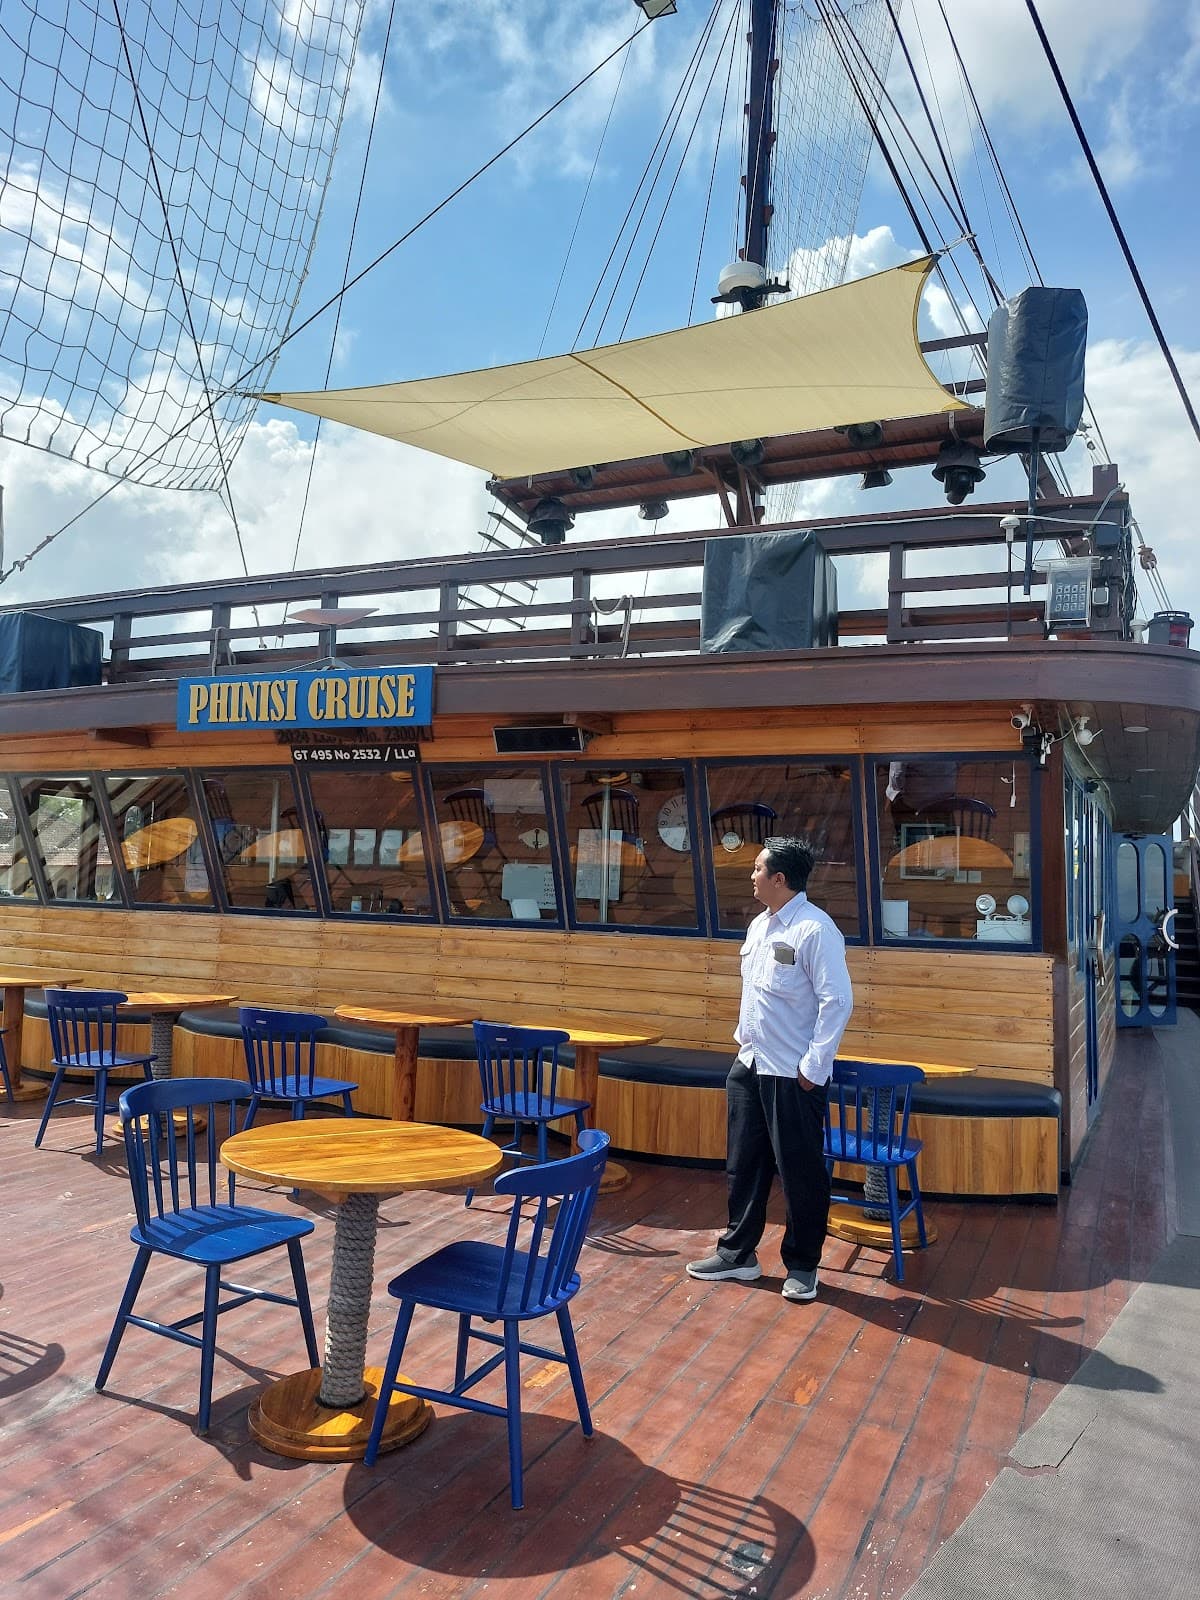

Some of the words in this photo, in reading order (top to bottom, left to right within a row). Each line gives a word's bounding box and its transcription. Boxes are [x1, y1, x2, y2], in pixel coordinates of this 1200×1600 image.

[188, 679, 299, 724] PHINISI
[307, 674, 415, 721] CRUISE
[293, 749, 308, 761] GT
[310, 749, 333, 761] 495
[334, 749, 351, 760] No
[351, 748, 381, 760] 2532
[384, 746, 391, 762] /
